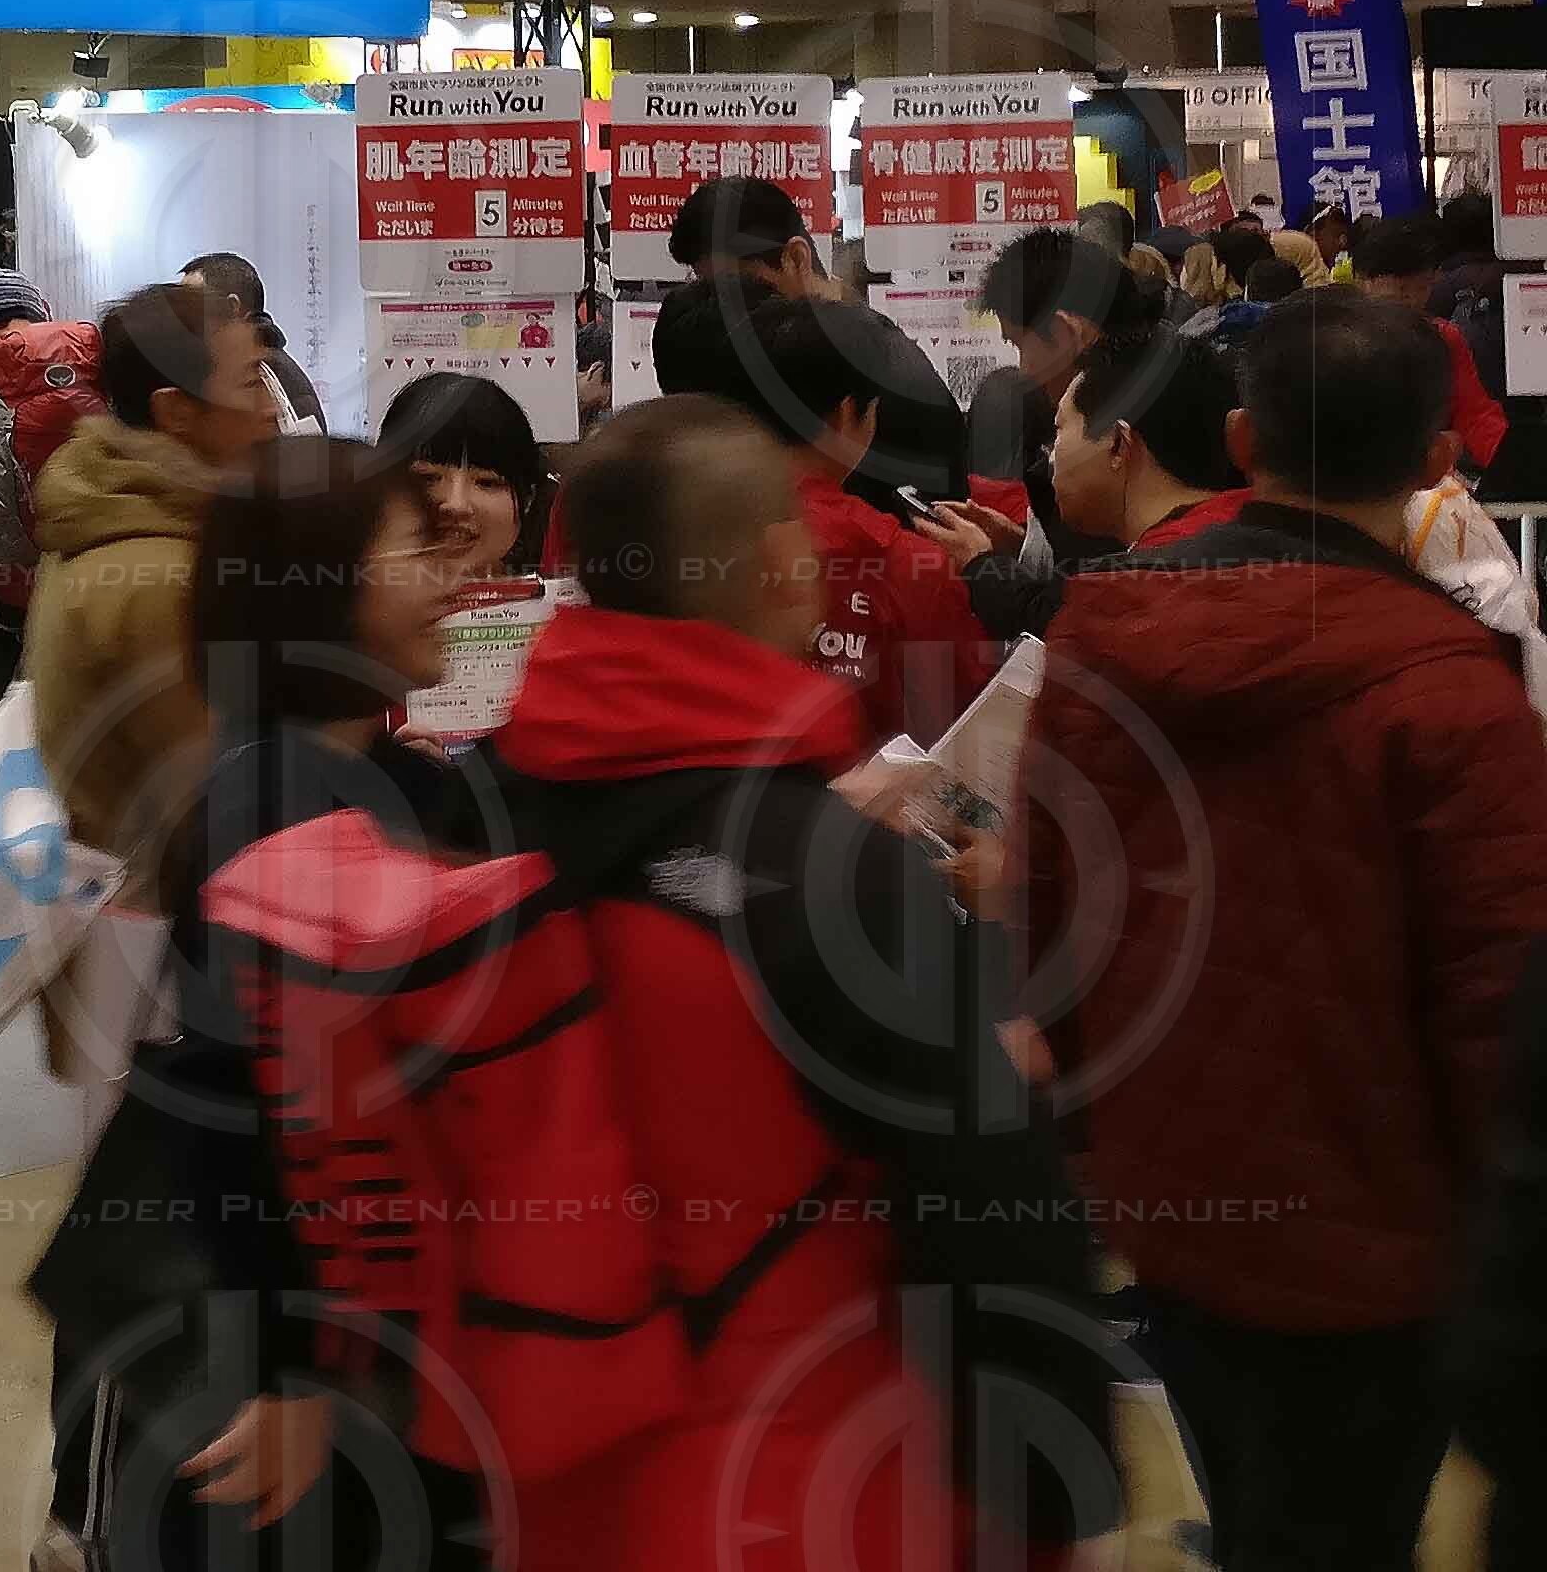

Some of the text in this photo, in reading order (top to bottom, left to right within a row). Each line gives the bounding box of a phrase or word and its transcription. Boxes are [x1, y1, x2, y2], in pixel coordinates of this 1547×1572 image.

[388, 90, 545, 118] Run with You
[645, 95, 798, 118] Run with You
[892, 93, 1040, 118] Run with You
[364, 137, 573, 180] 肌年齢測定
[618, 139, 822, 180] 血管年齢測定
[868, 137, 1069, 177] 骨健康度測定
[375, 197, 564, 228] Wait Time 5 Minutes
[982, 188, 1000, 213] 5
[375, 216, 564, 237] ただいま 分待ち
[629, 210, 678, 229] ただい
